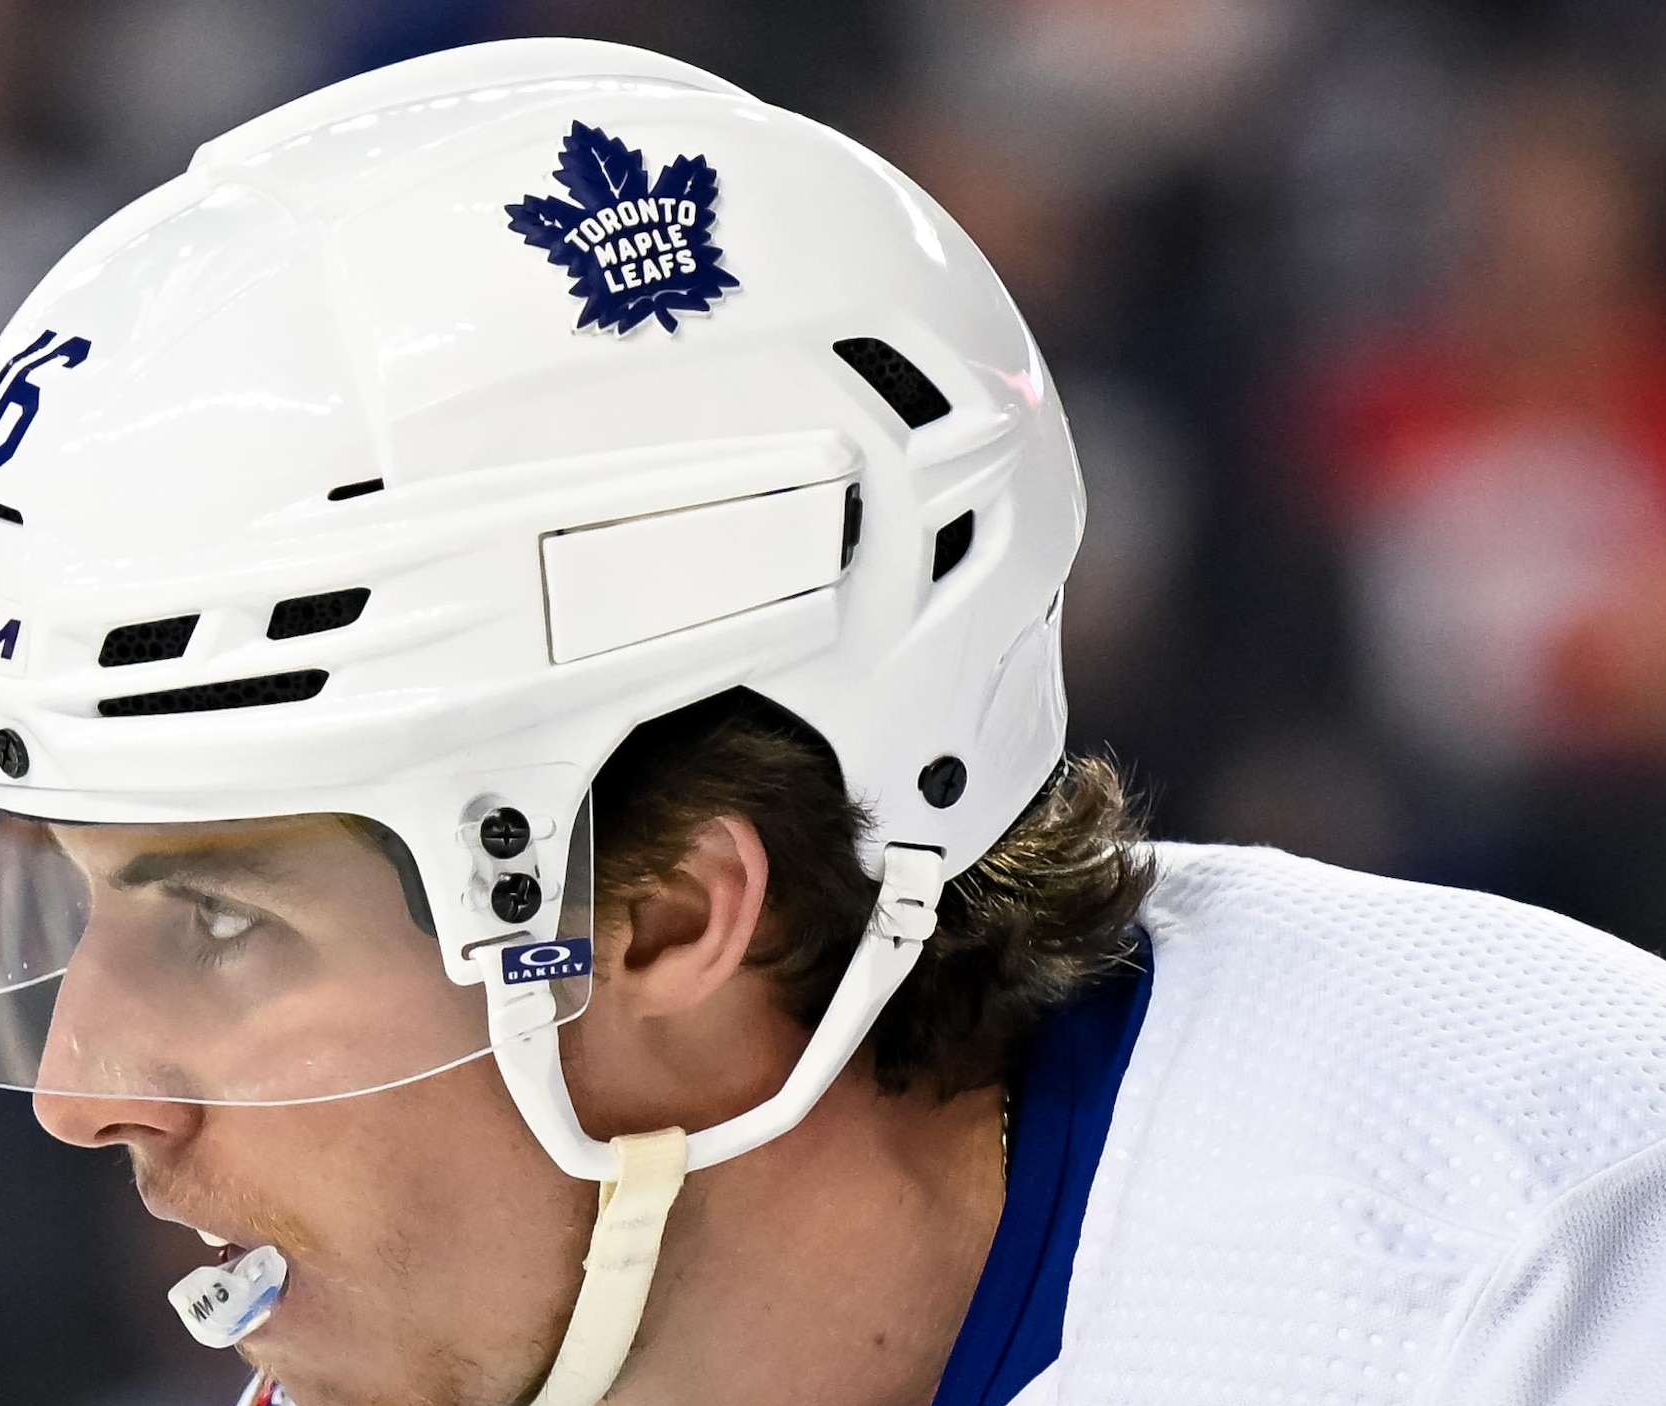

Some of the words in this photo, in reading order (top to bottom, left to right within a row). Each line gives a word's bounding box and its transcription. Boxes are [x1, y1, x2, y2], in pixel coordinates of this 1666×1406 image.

[564, 197, 697, 253] TORONTO
[594, 223, 688, 269] MAPLE
[603, 249, 697, 294] LEAFS
[507, 962, 584, 981] OAKLEY
